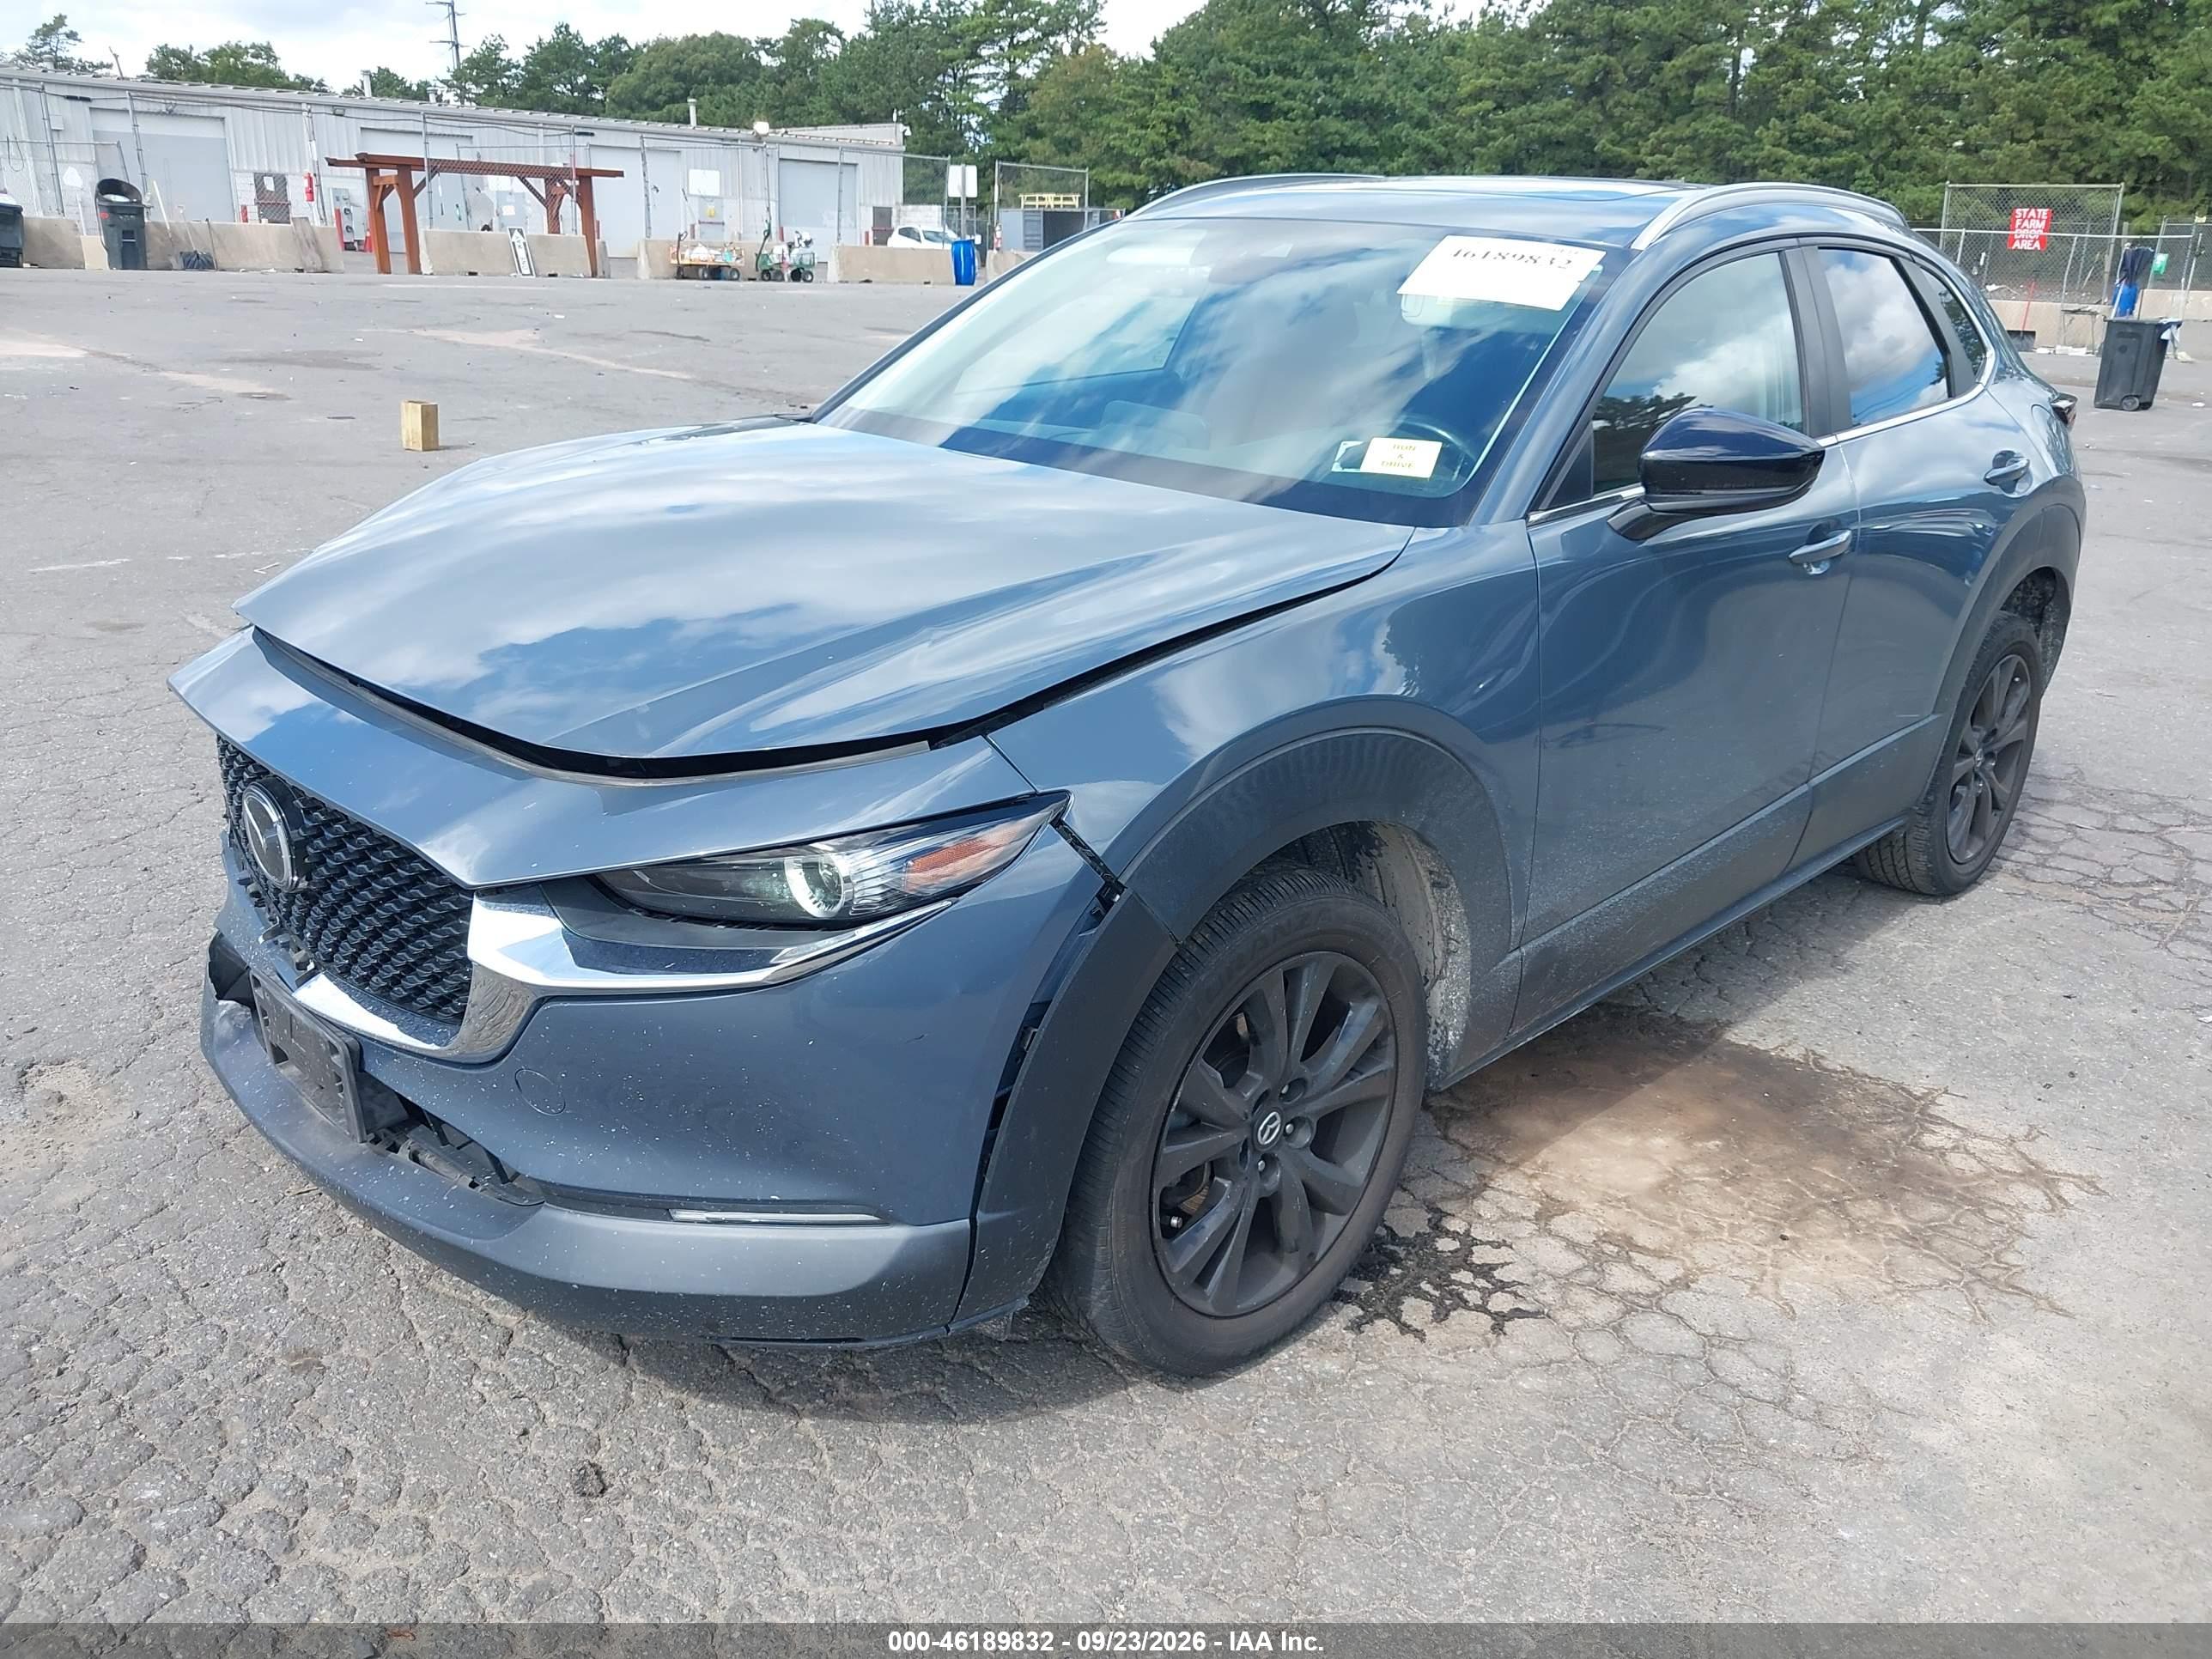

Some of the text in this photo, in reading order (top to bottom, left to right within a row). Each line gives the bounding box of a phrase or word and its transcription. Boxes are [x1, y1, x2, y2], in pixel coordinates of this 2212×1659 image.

[2015, 208, 2050, 220] STATE
[2014, 218, 2046, 229] FARM
[2014, 228, 2043, 240] DROP
[2011, 239, 2041, 251] AREA
